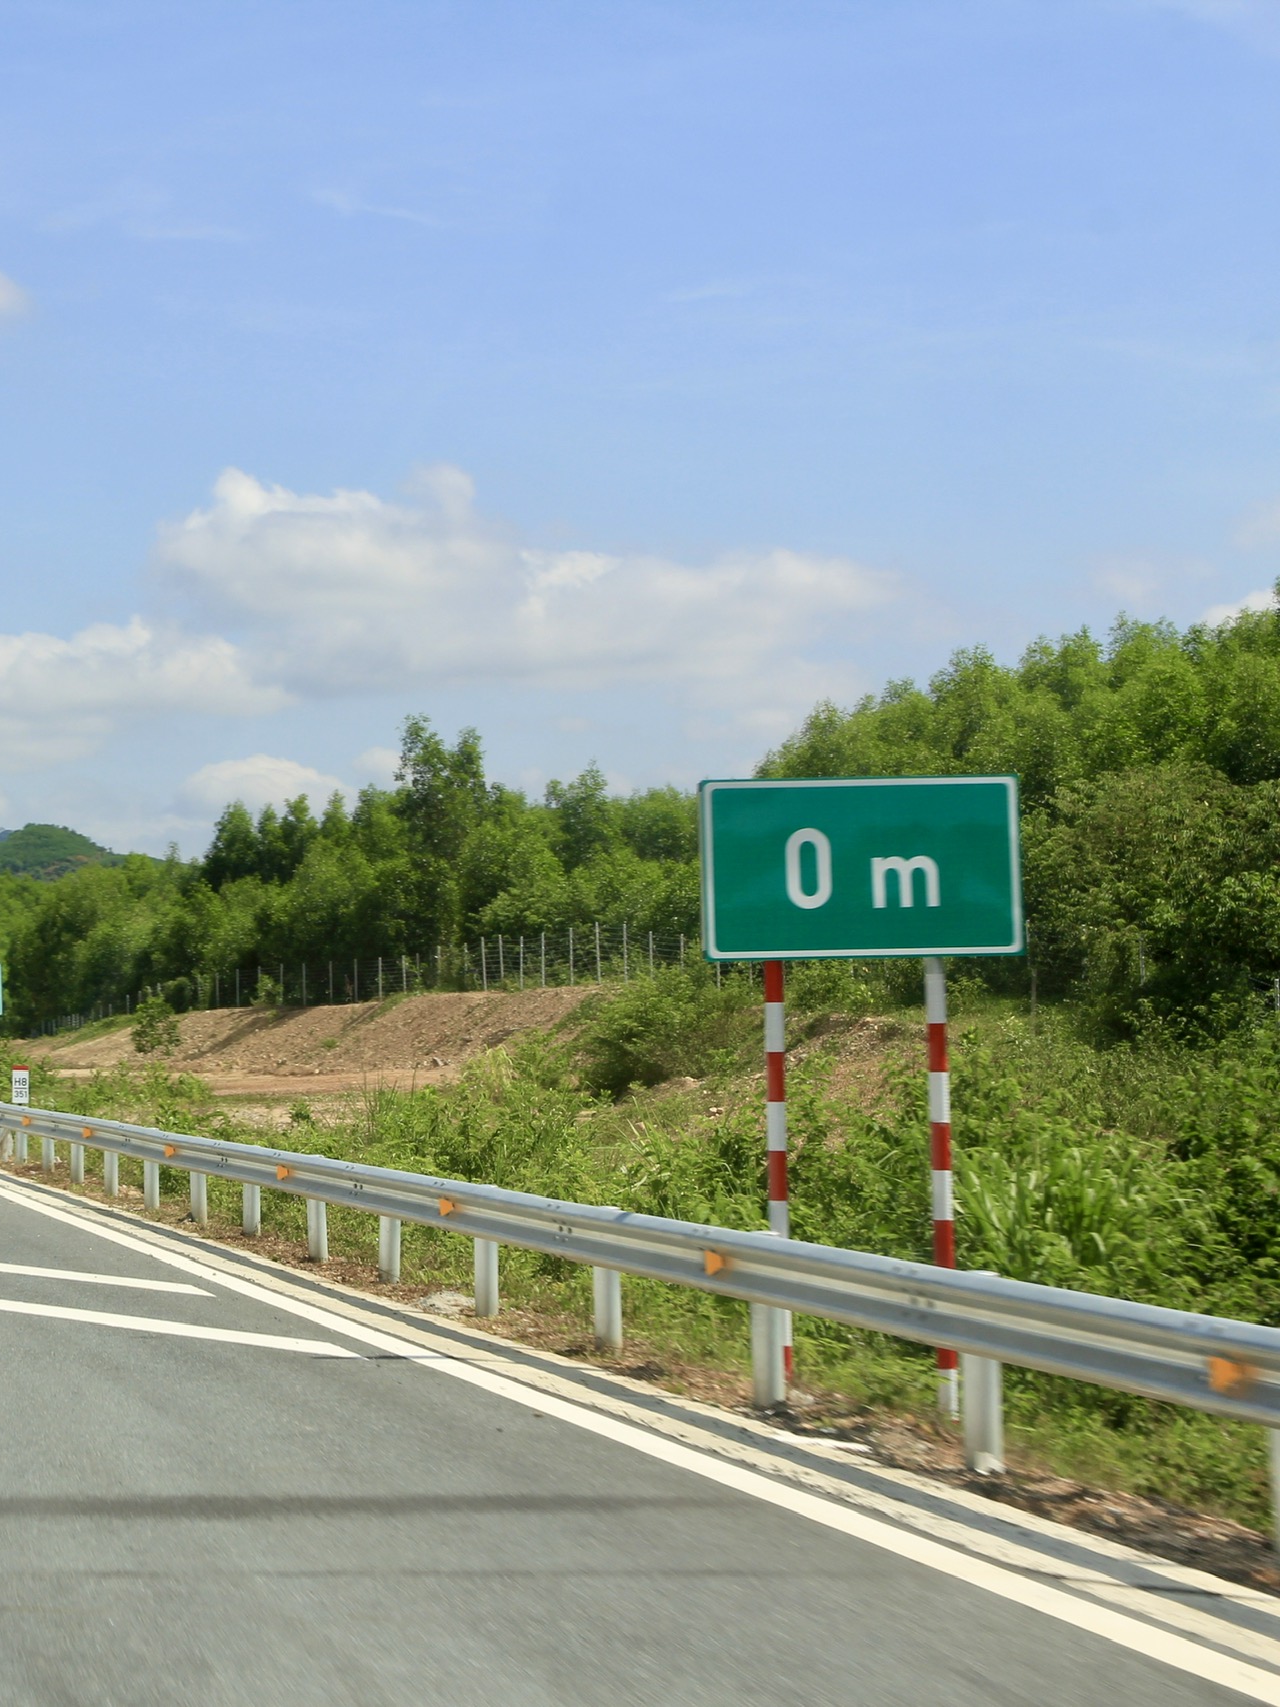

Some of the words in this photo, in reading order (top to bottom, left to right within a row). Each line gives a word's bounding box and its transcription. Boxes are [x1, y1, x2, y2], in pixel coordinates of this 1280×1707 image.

[785, 827, 833, 910] 0
[870, 855, 941, 909] m
[14, 1077, 28, 1087] H8
[14, 1090, 28, 1098] 351
